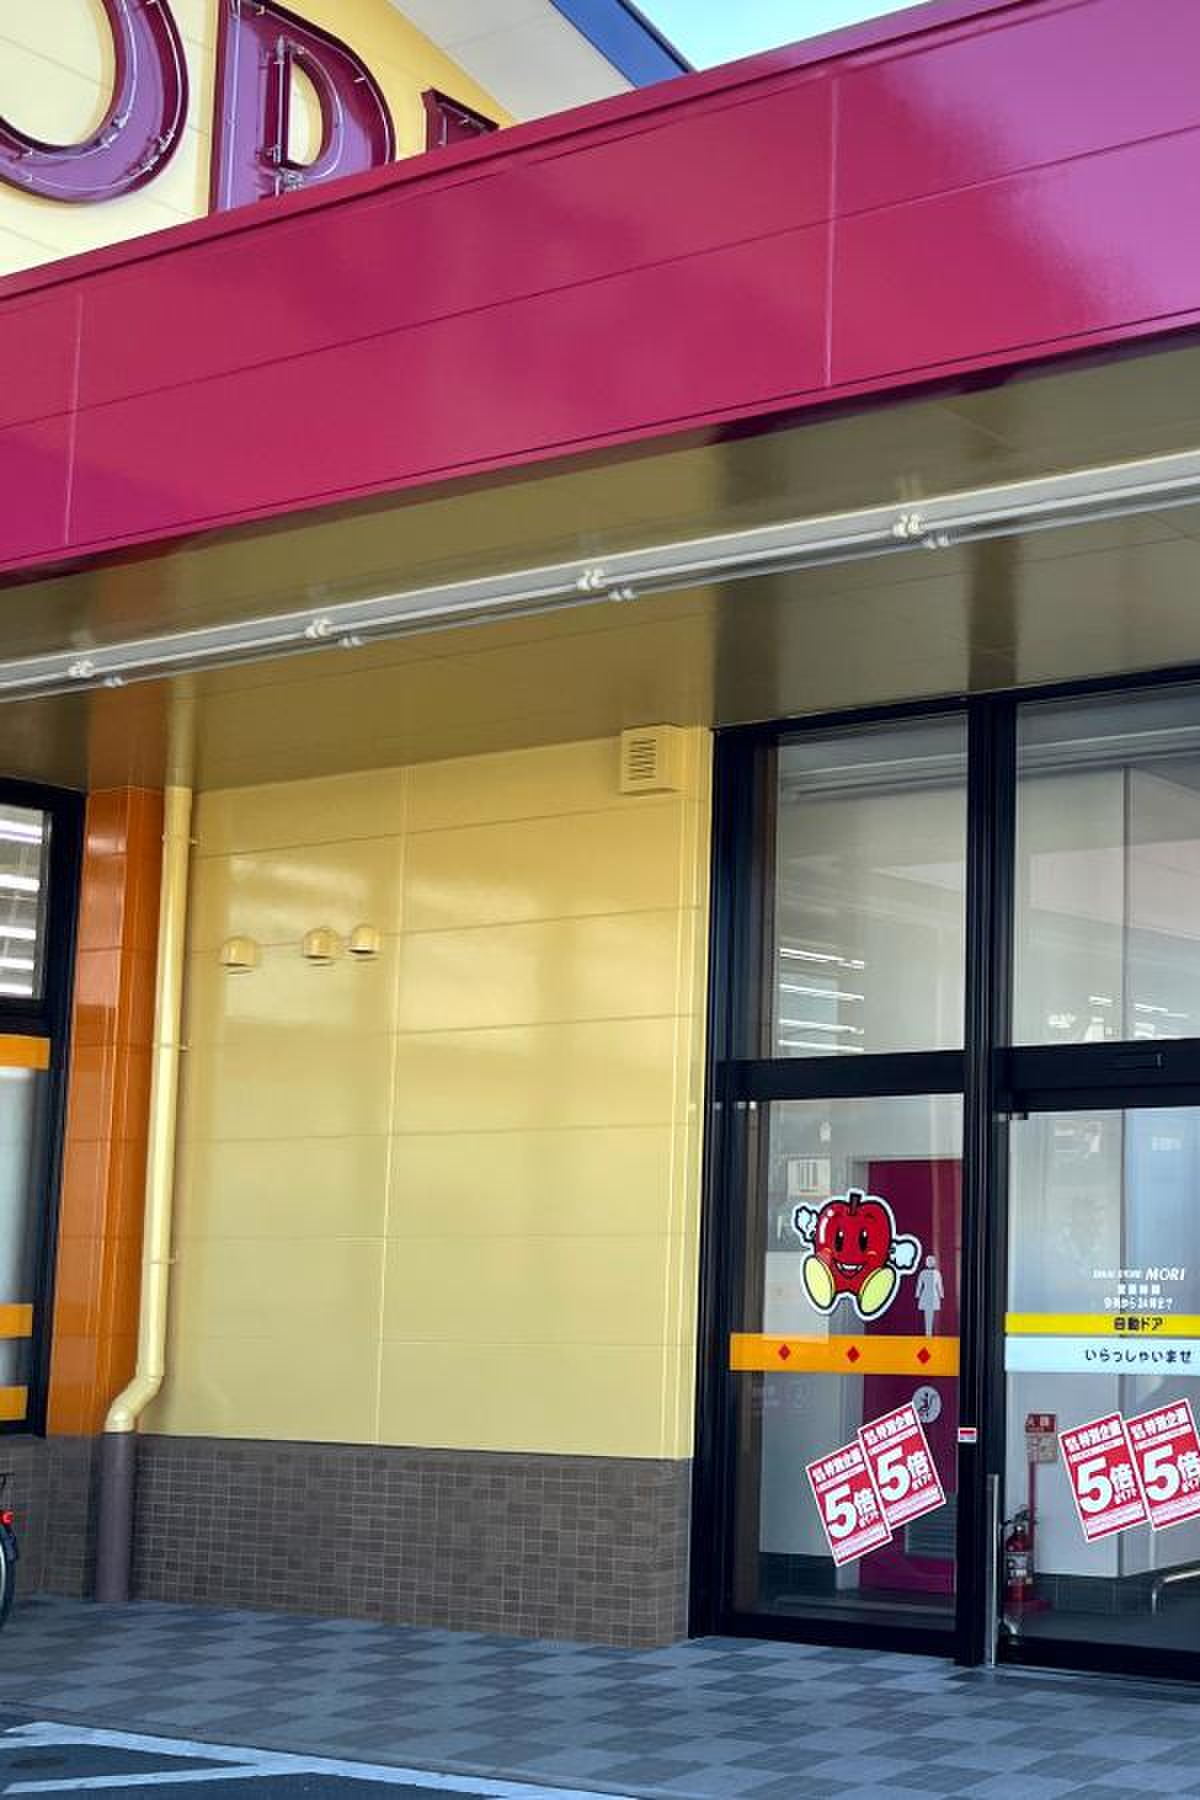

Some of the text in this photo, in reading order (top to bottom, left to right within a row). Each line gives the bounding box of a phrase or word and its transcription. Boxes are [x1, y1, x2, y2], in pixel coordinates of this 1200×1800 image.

[1145, 1267, 1185, 1281] MORI
[1113, 1317, 1164, 1331] 自動ドア
[1085, 1349, 1193, 1364] いらっしゃいませ
